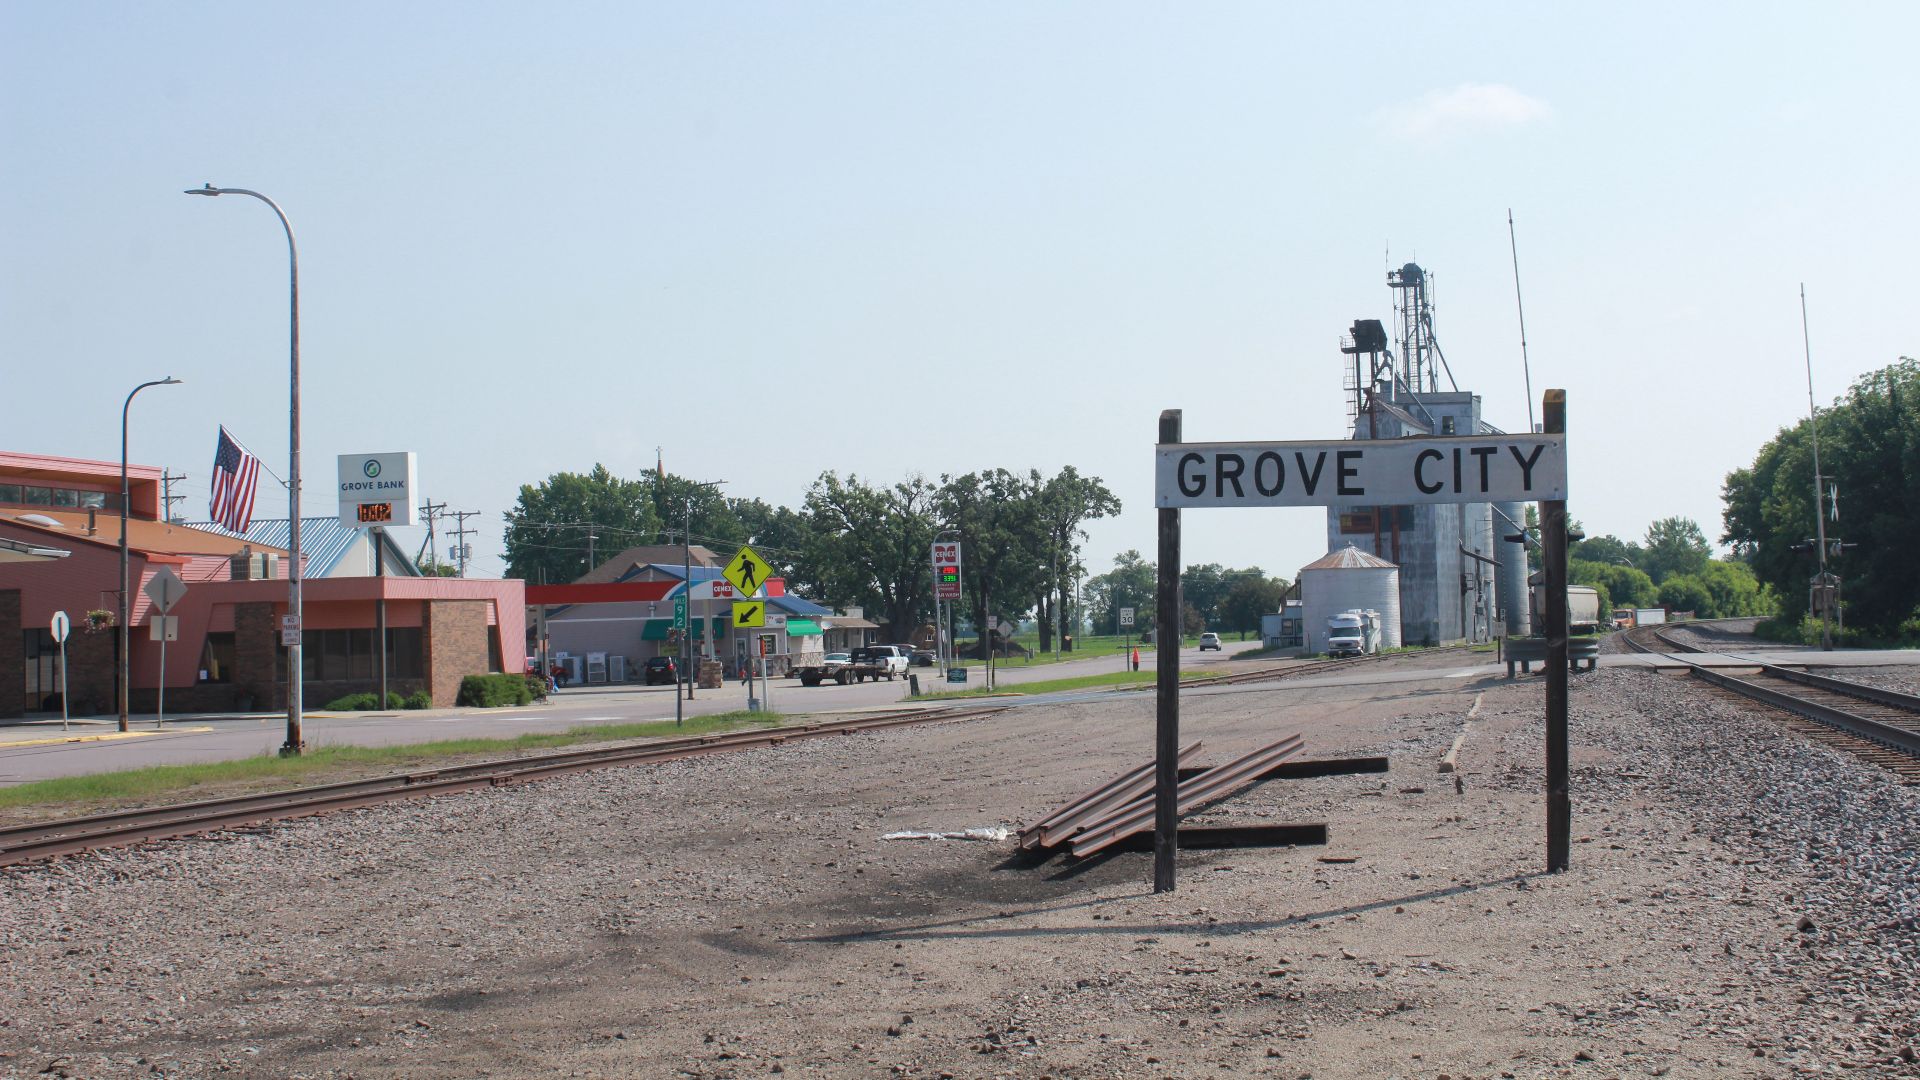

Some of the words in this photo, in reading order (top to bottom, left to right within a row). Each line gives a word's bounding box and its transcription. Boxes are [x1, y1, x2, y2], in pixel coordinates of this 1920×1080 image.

[1177, 450, 1365, 498] GROVE
[1414, 444, 1545, 495] CITY
[341, 482, 374, 491] GROVE
[377, 480, 405, 489] BANK
[1121, 616, 1133, 624] 30
